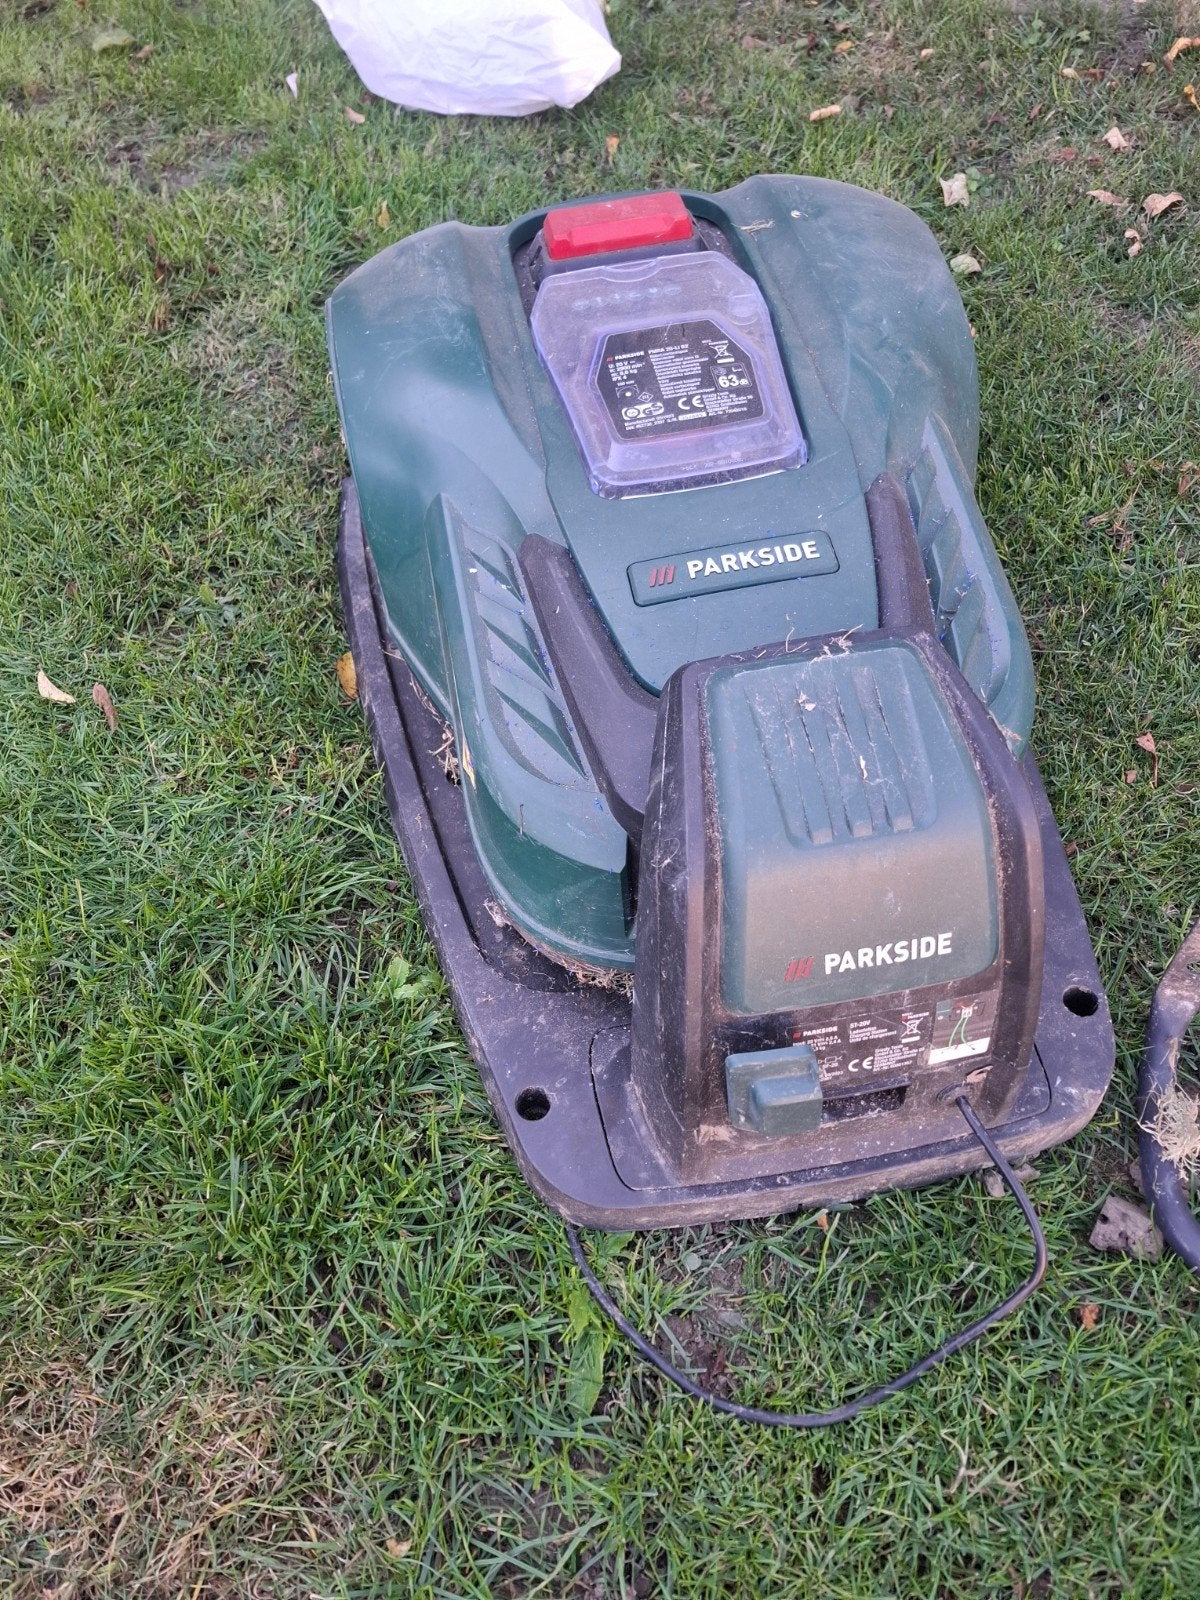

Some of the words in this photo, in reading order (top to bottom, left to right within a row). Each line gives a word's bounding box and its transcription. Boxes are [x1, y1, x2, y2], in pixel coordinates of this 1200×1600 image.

[718, 375, 739, 387] 63
[686, 540, 821, 579] PARKSIDE
[824, 932, 953, 974] PARKSIDE
[803, 1026, 838, 1036] PARKSIDE
